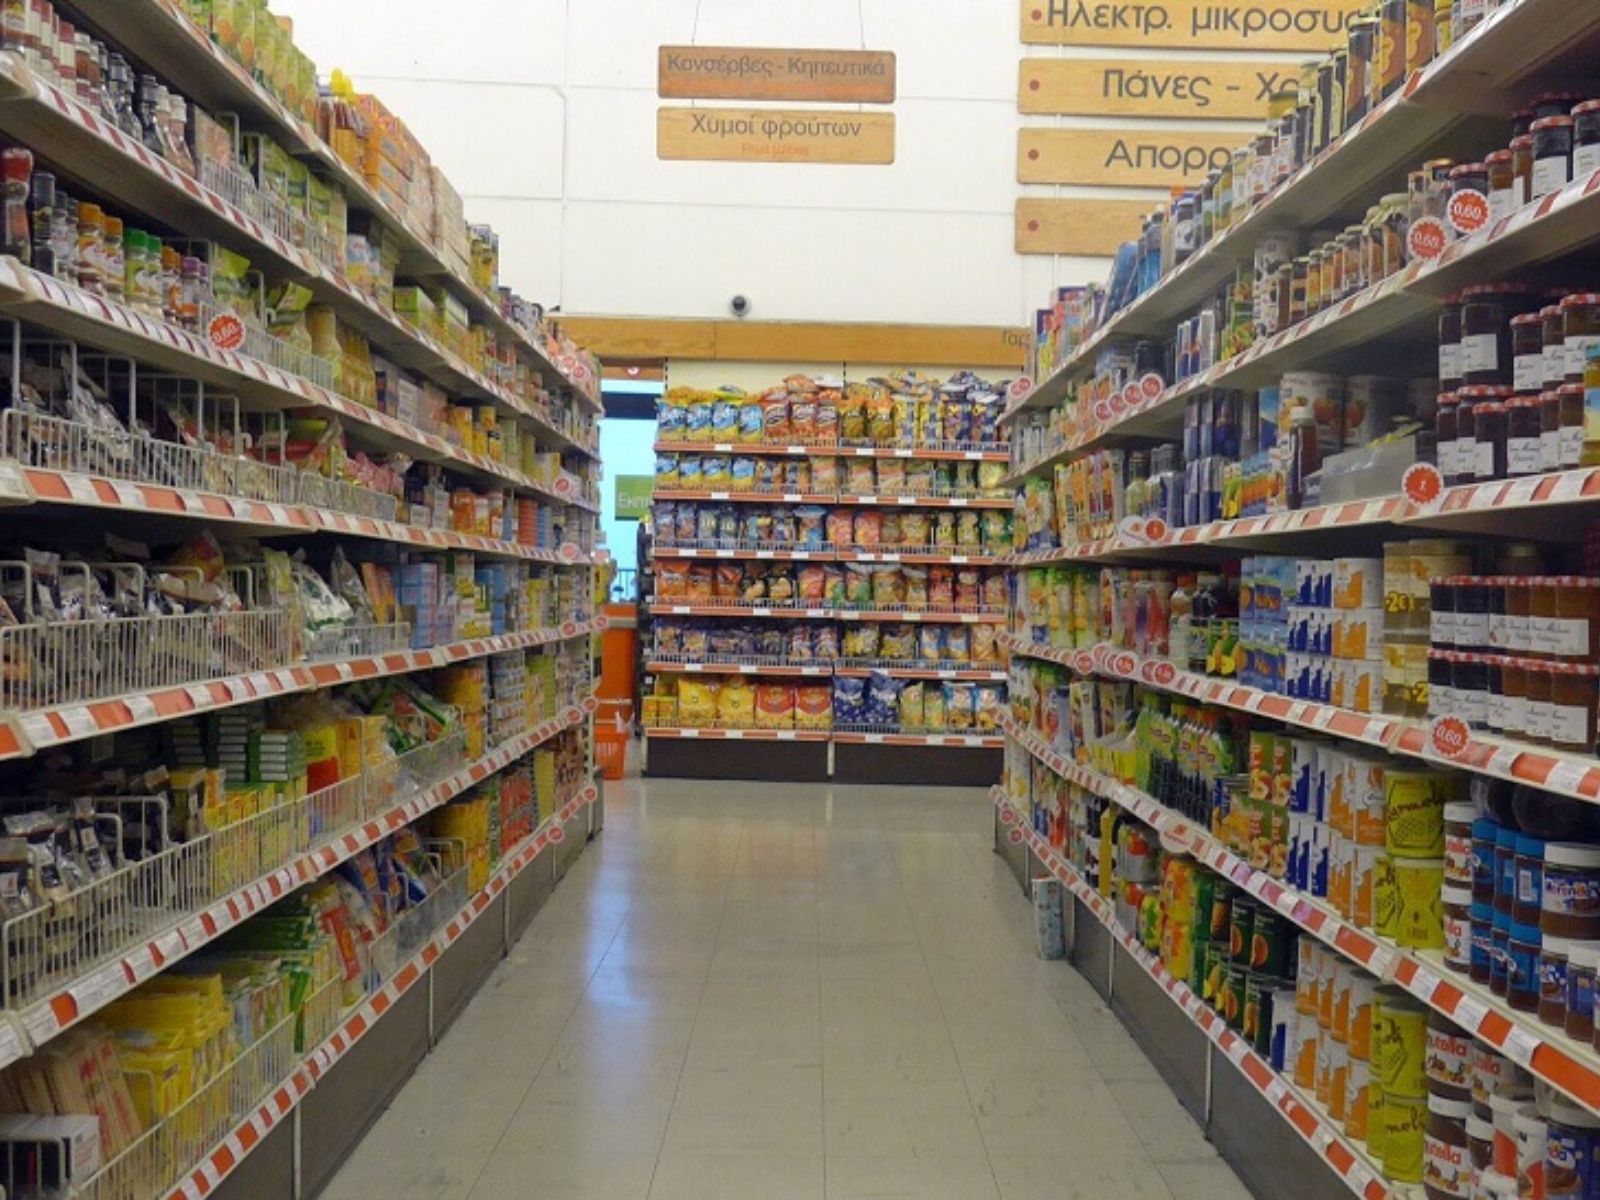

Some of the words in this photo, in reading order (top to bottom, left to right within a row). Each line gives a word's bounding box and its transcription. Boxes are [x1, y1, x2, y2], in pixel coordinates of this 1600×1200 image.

[788, 56, 886, 79] Κηπευτικά
[1102, 68, 1212, 107] Πάνες
[691, 113, 755, 138] Χυμοί
[761, 115, 862, 140] φρούτων
